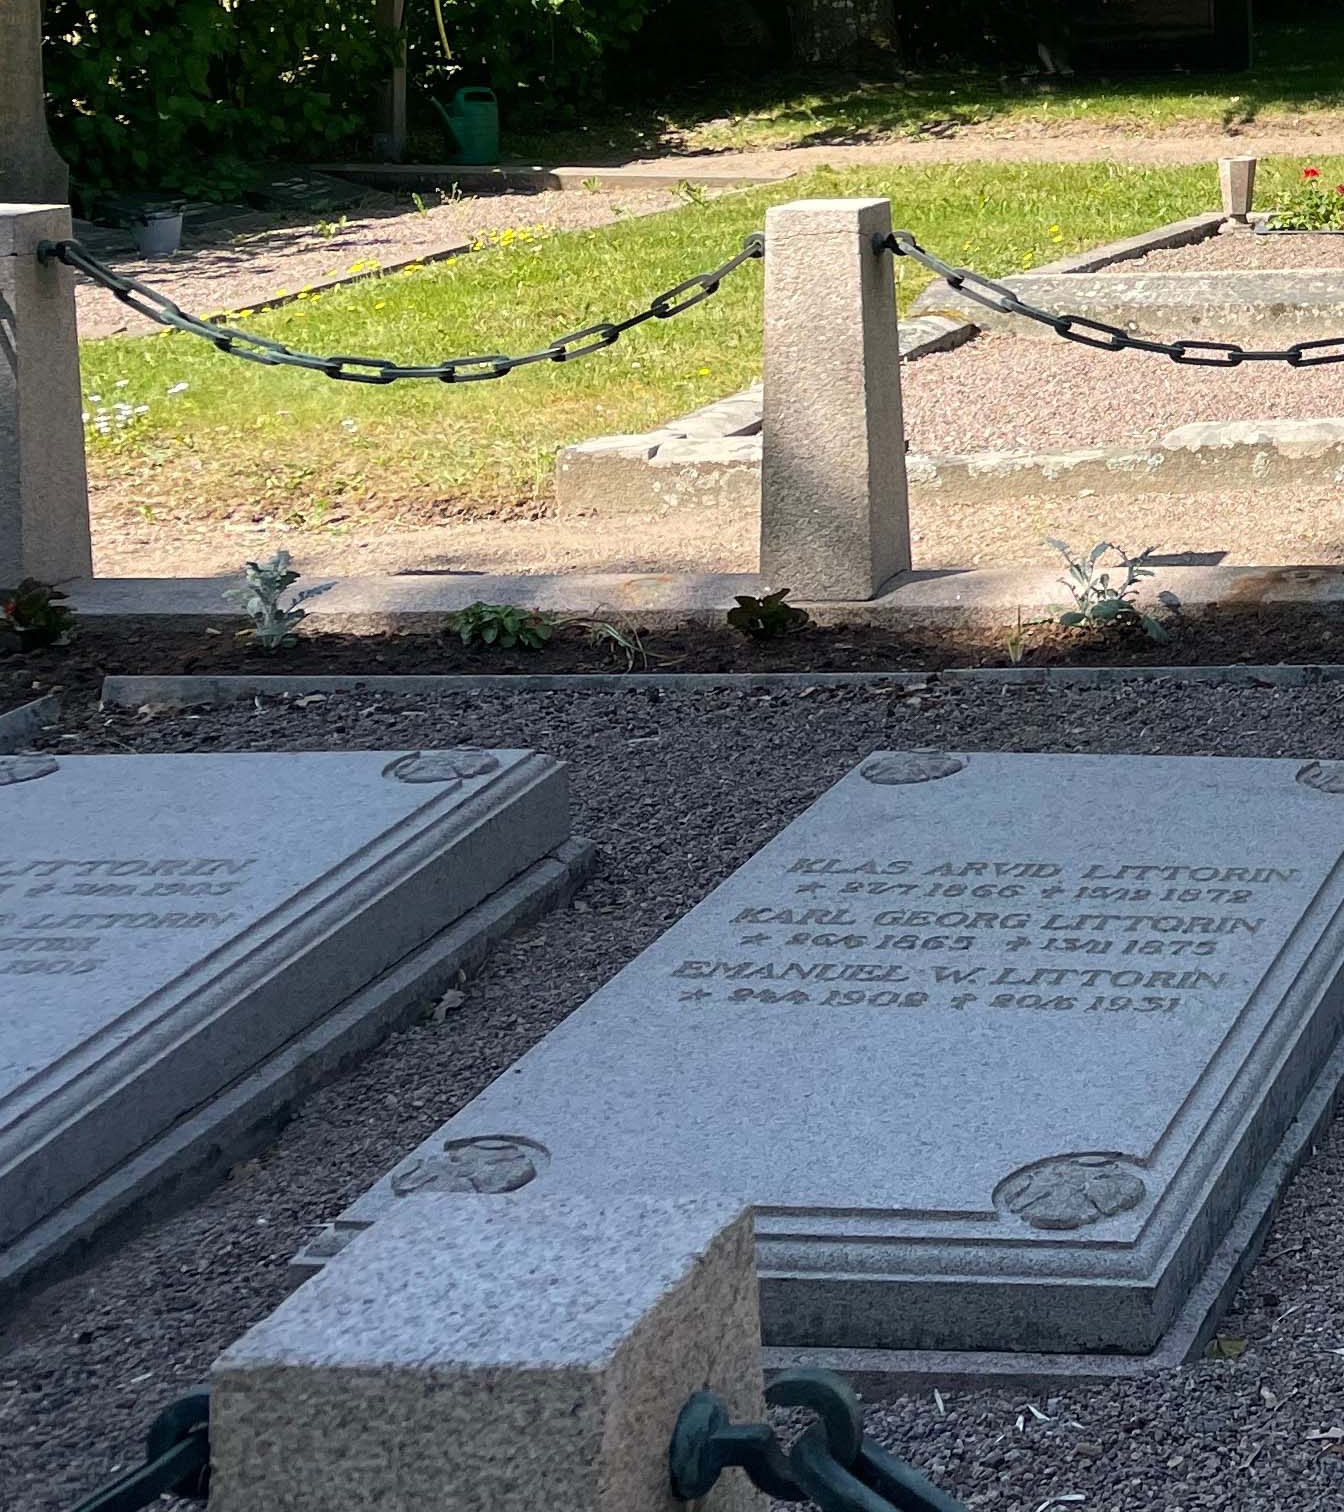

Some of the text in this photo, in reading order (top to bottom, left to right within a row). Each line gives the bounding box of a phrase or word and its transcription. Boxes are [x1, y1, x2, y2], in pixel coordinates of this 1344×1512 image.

[786, 857, 1303, 884] KLAS ARVID LITTORIN
[20, 911, 239, 930] LITTORIN
[728, 907, 1267, 935] KARL GEORG LITTORIN
[669, 960, 1229, 990] EMANUEL W. LITTORIN
